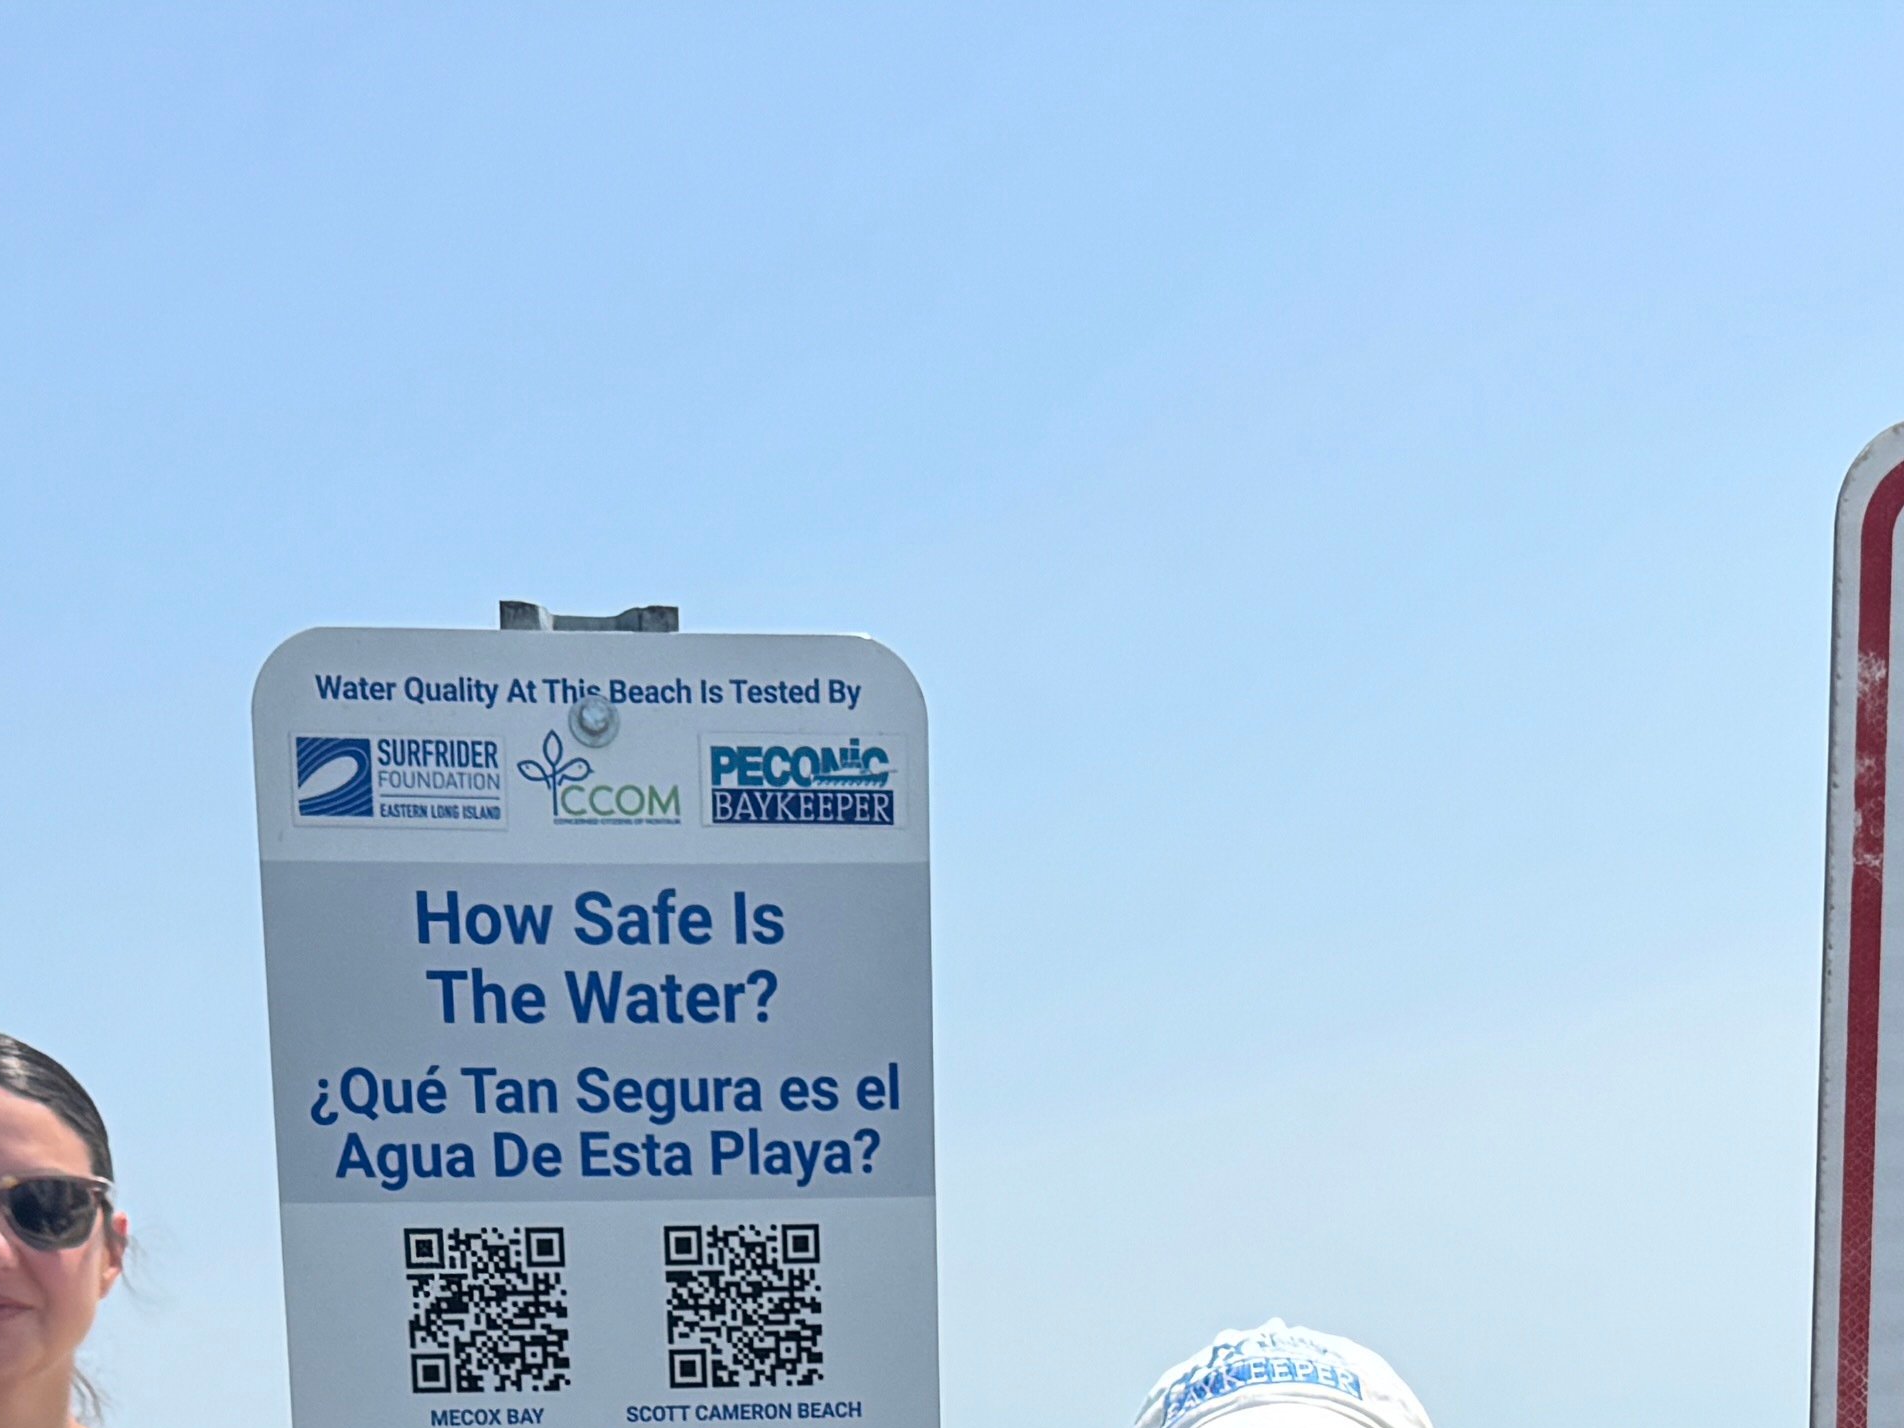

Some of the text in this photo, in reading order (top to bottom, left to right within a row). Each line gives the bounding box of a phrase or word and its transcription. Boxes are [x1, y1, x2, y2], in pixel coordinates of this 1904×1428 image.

[315, 675, 861, 710] Water Quality At This Beach Is Tested By
[378, 739, 498, 768] SURFRIDER
[378, 770, 500, 790] FOUNDATION
[380, 804, 459, 819] EASTERN LONG
[561, 784, 681, 818] CCOM
[714, 791, 892, 823] BAYKEEPER
[416, 888, 784, 945] How Safe Is
[426, 968, 777, 1024] The Water?
[311, 1063, 899, 1125] ¿Qué Tan Segura es el
[336, 1128, 880, 1191] Agua De Esta Playa?
[431, 1408, 544, 1426] MECOX BAY
[627, 1401, 861, 1422] SCOTT CAMERON BEACH
